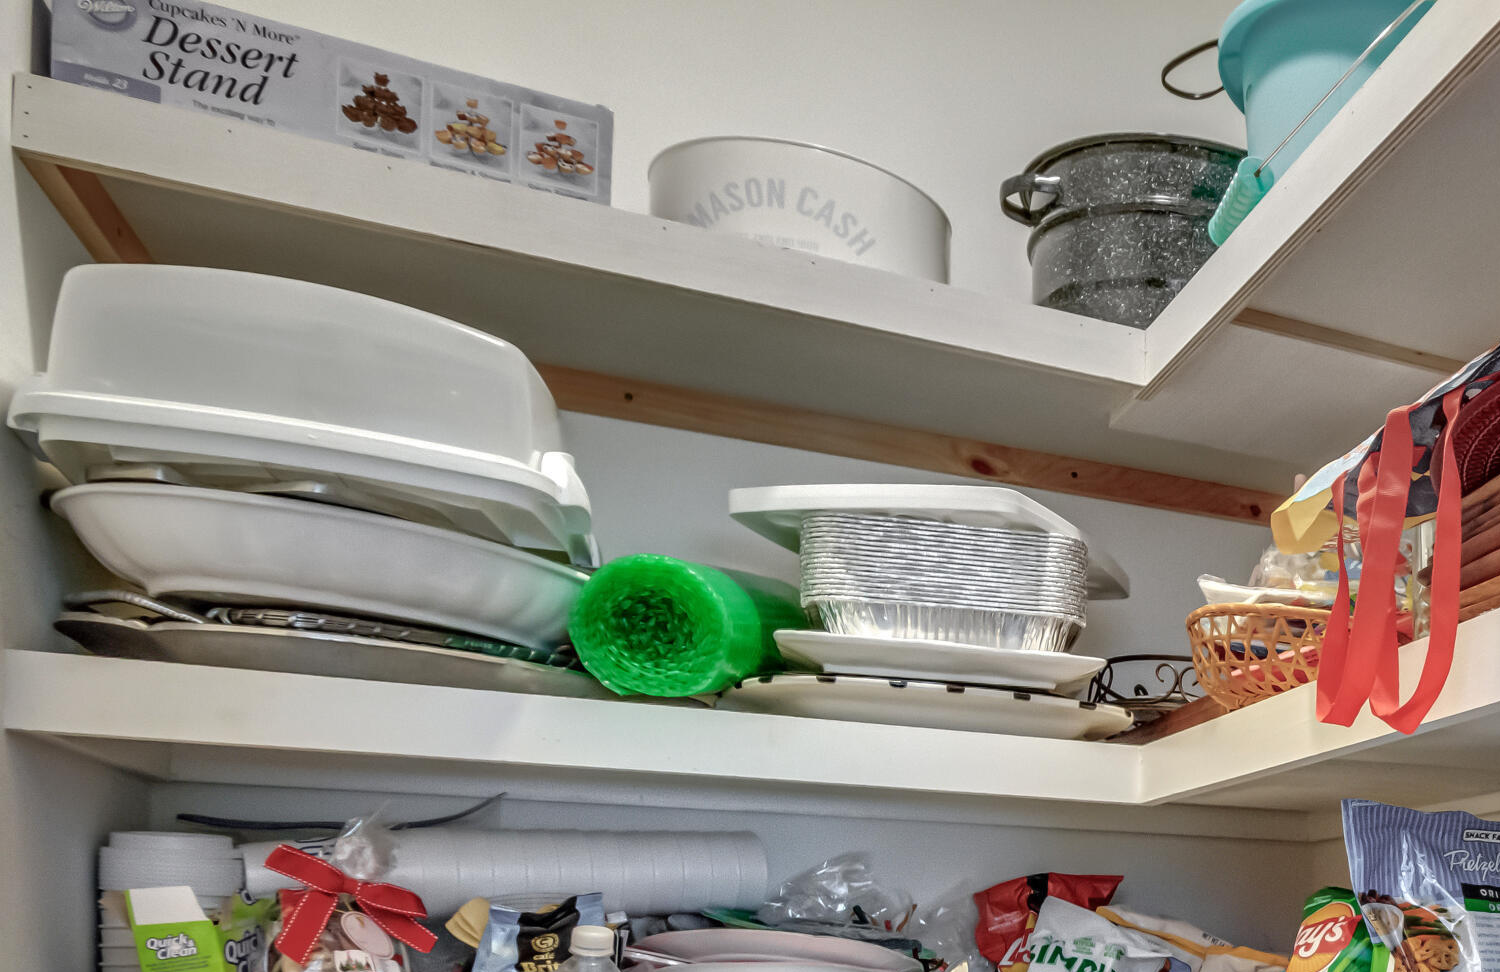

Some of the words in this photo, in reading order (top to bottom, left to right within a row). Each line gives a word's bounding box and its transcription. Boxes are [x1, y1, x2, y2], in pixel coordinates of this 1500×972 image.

[150, 0, 227, 28] Cupcakes
[142, 15, 300, 78] Dessert
[142, 50, 269, 106] Stand
[688, 178, 786, 230] MASON
[795, 185, 877, 257] CASH
[1464, 832, 1490, 841] SNACK
[146, 933, 189, 951] Quick
[157, 945, 198, 960] Clean
[1295, 916, 1345, 958] ay's
